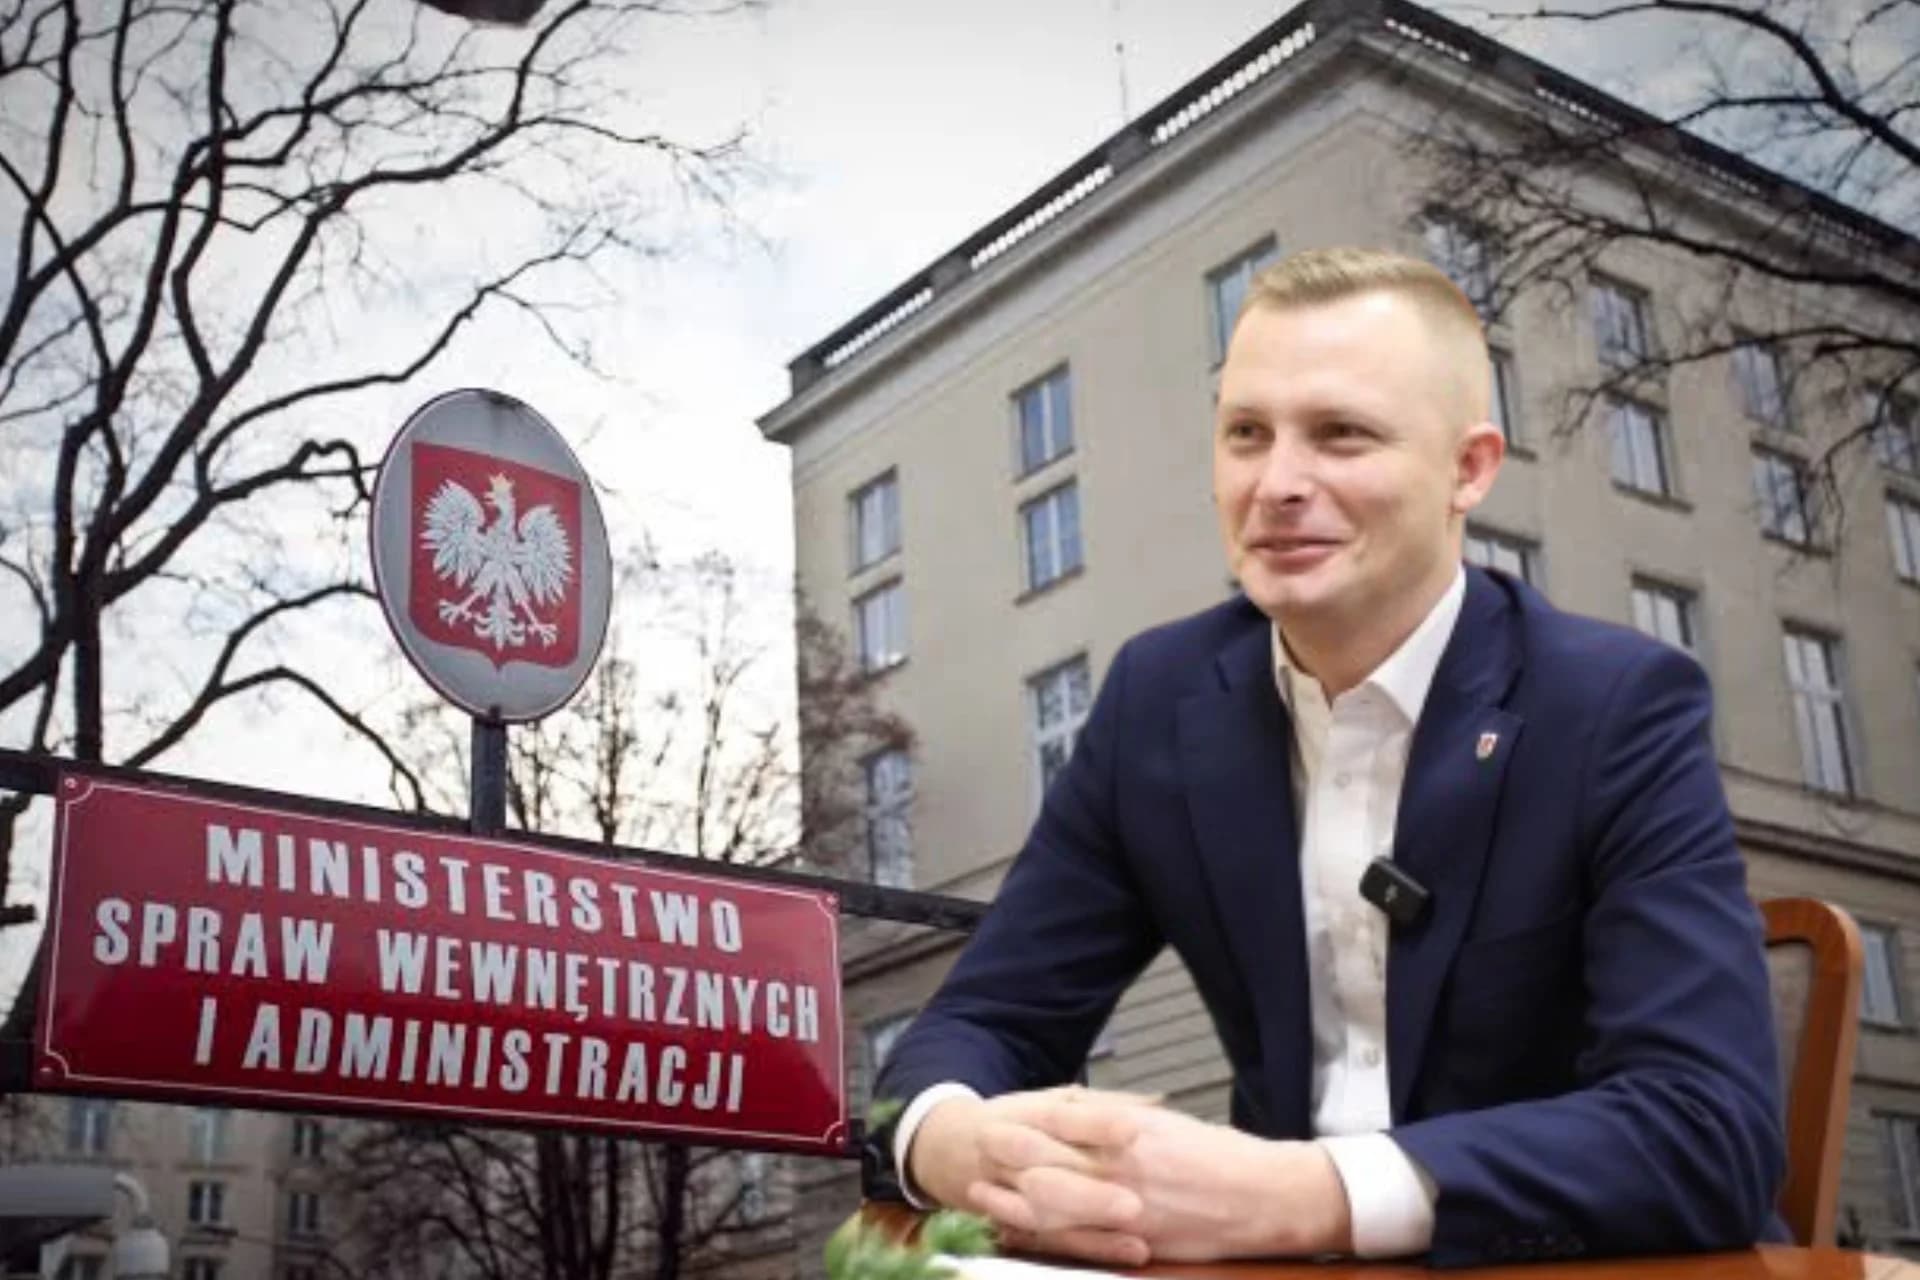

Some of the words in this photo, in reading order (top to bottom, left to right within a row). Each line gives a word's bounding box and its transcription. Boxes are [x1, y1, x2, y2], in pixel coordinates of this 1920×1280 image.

[206, 823, 743, 954] MINISTERSTWO
[94, 898, 334, 985] SPRAW
[377, 928, 820, 1044] WEWNĘTRZNYCH
[195, 997, 217, 1064] I
[243, 1004, 745, 1113] ADMINISTRACJI
